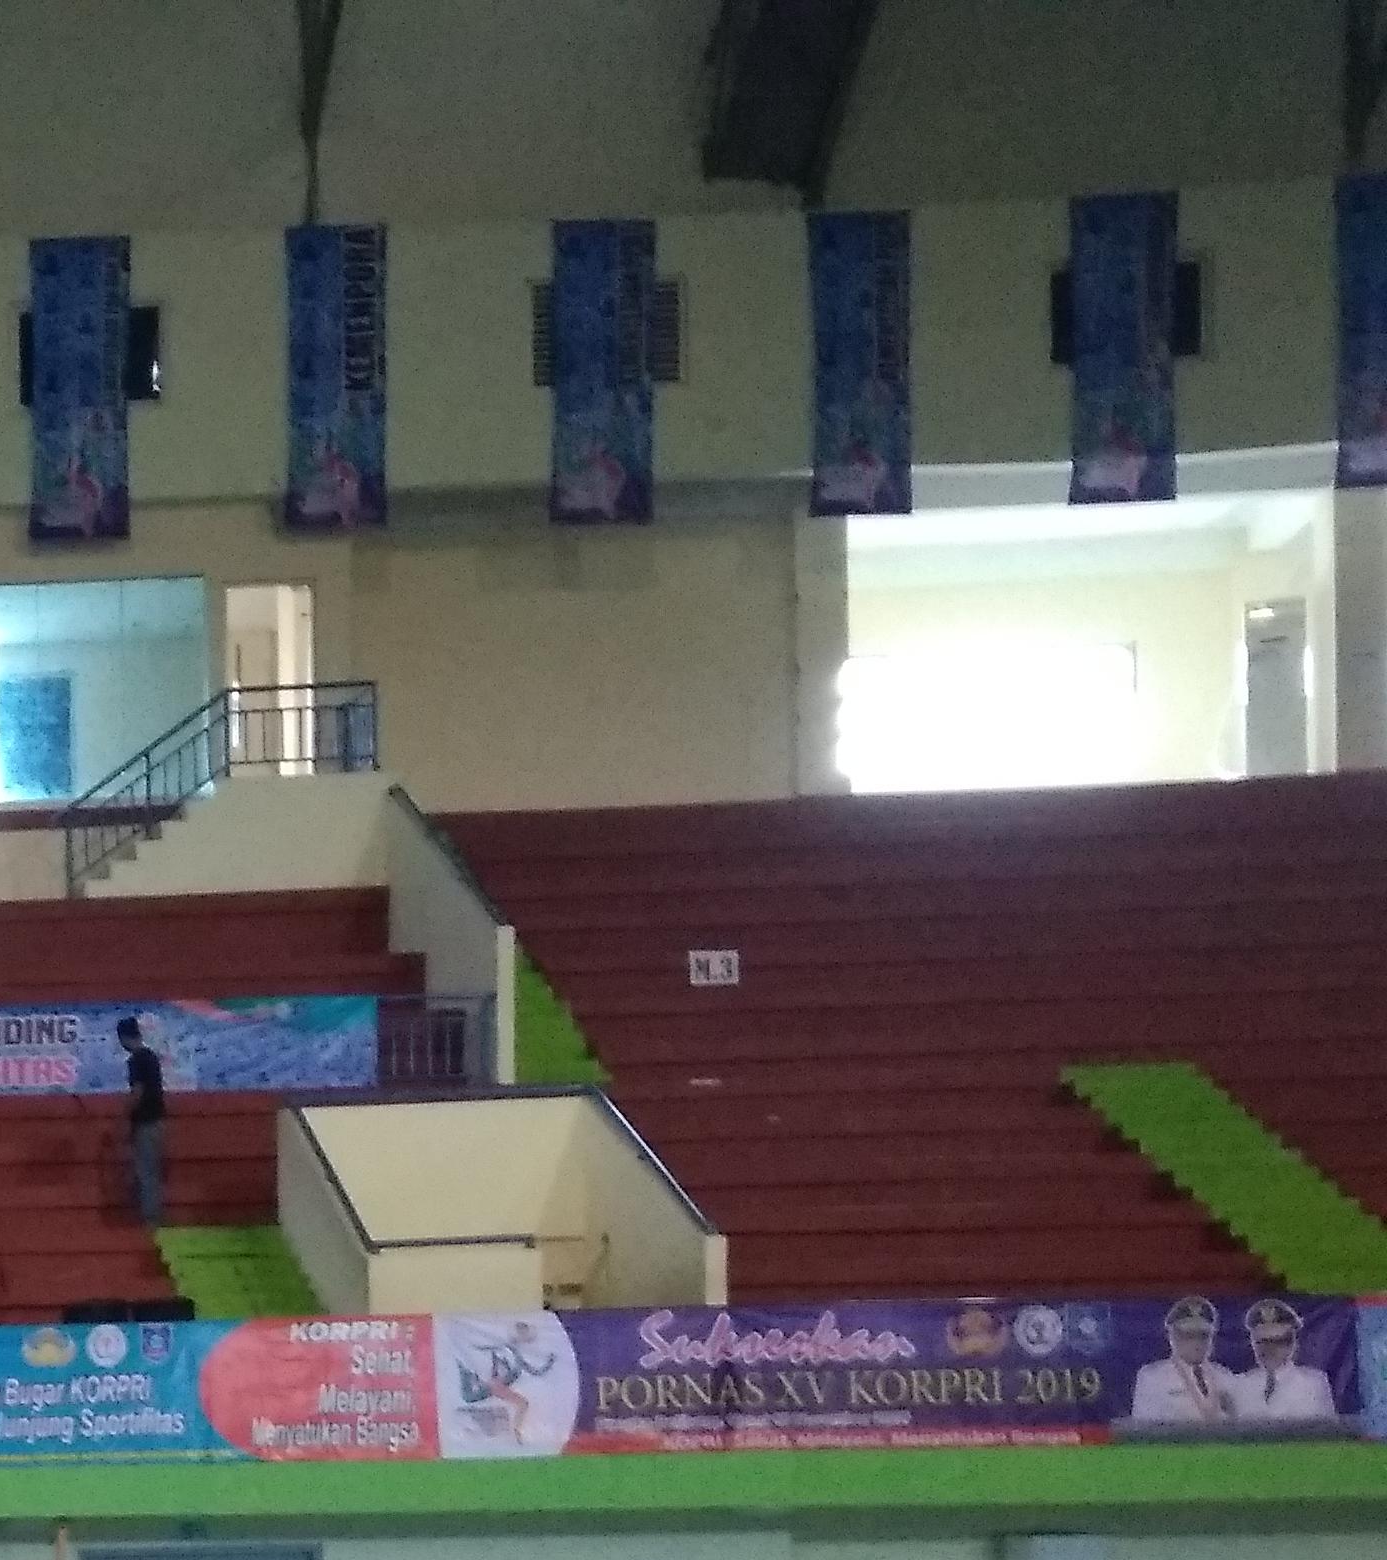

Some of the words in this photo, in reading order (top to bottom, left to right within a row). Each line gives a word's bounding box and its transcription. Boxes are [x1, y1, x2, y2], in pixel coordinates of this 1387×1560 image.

[291, 1321, 398, 1343] KORPRI
[5, 1377, 64, 1411] Bugar
[70, 1373, 152, 1403] KORPRI
[596, 1372, 765, 1410] PORNAS
[776, 1371, 834, 1408] XV
[849, 1368, 1004, 1405] KORPRI
[1015, 1368, 1101, 1403] 2019
